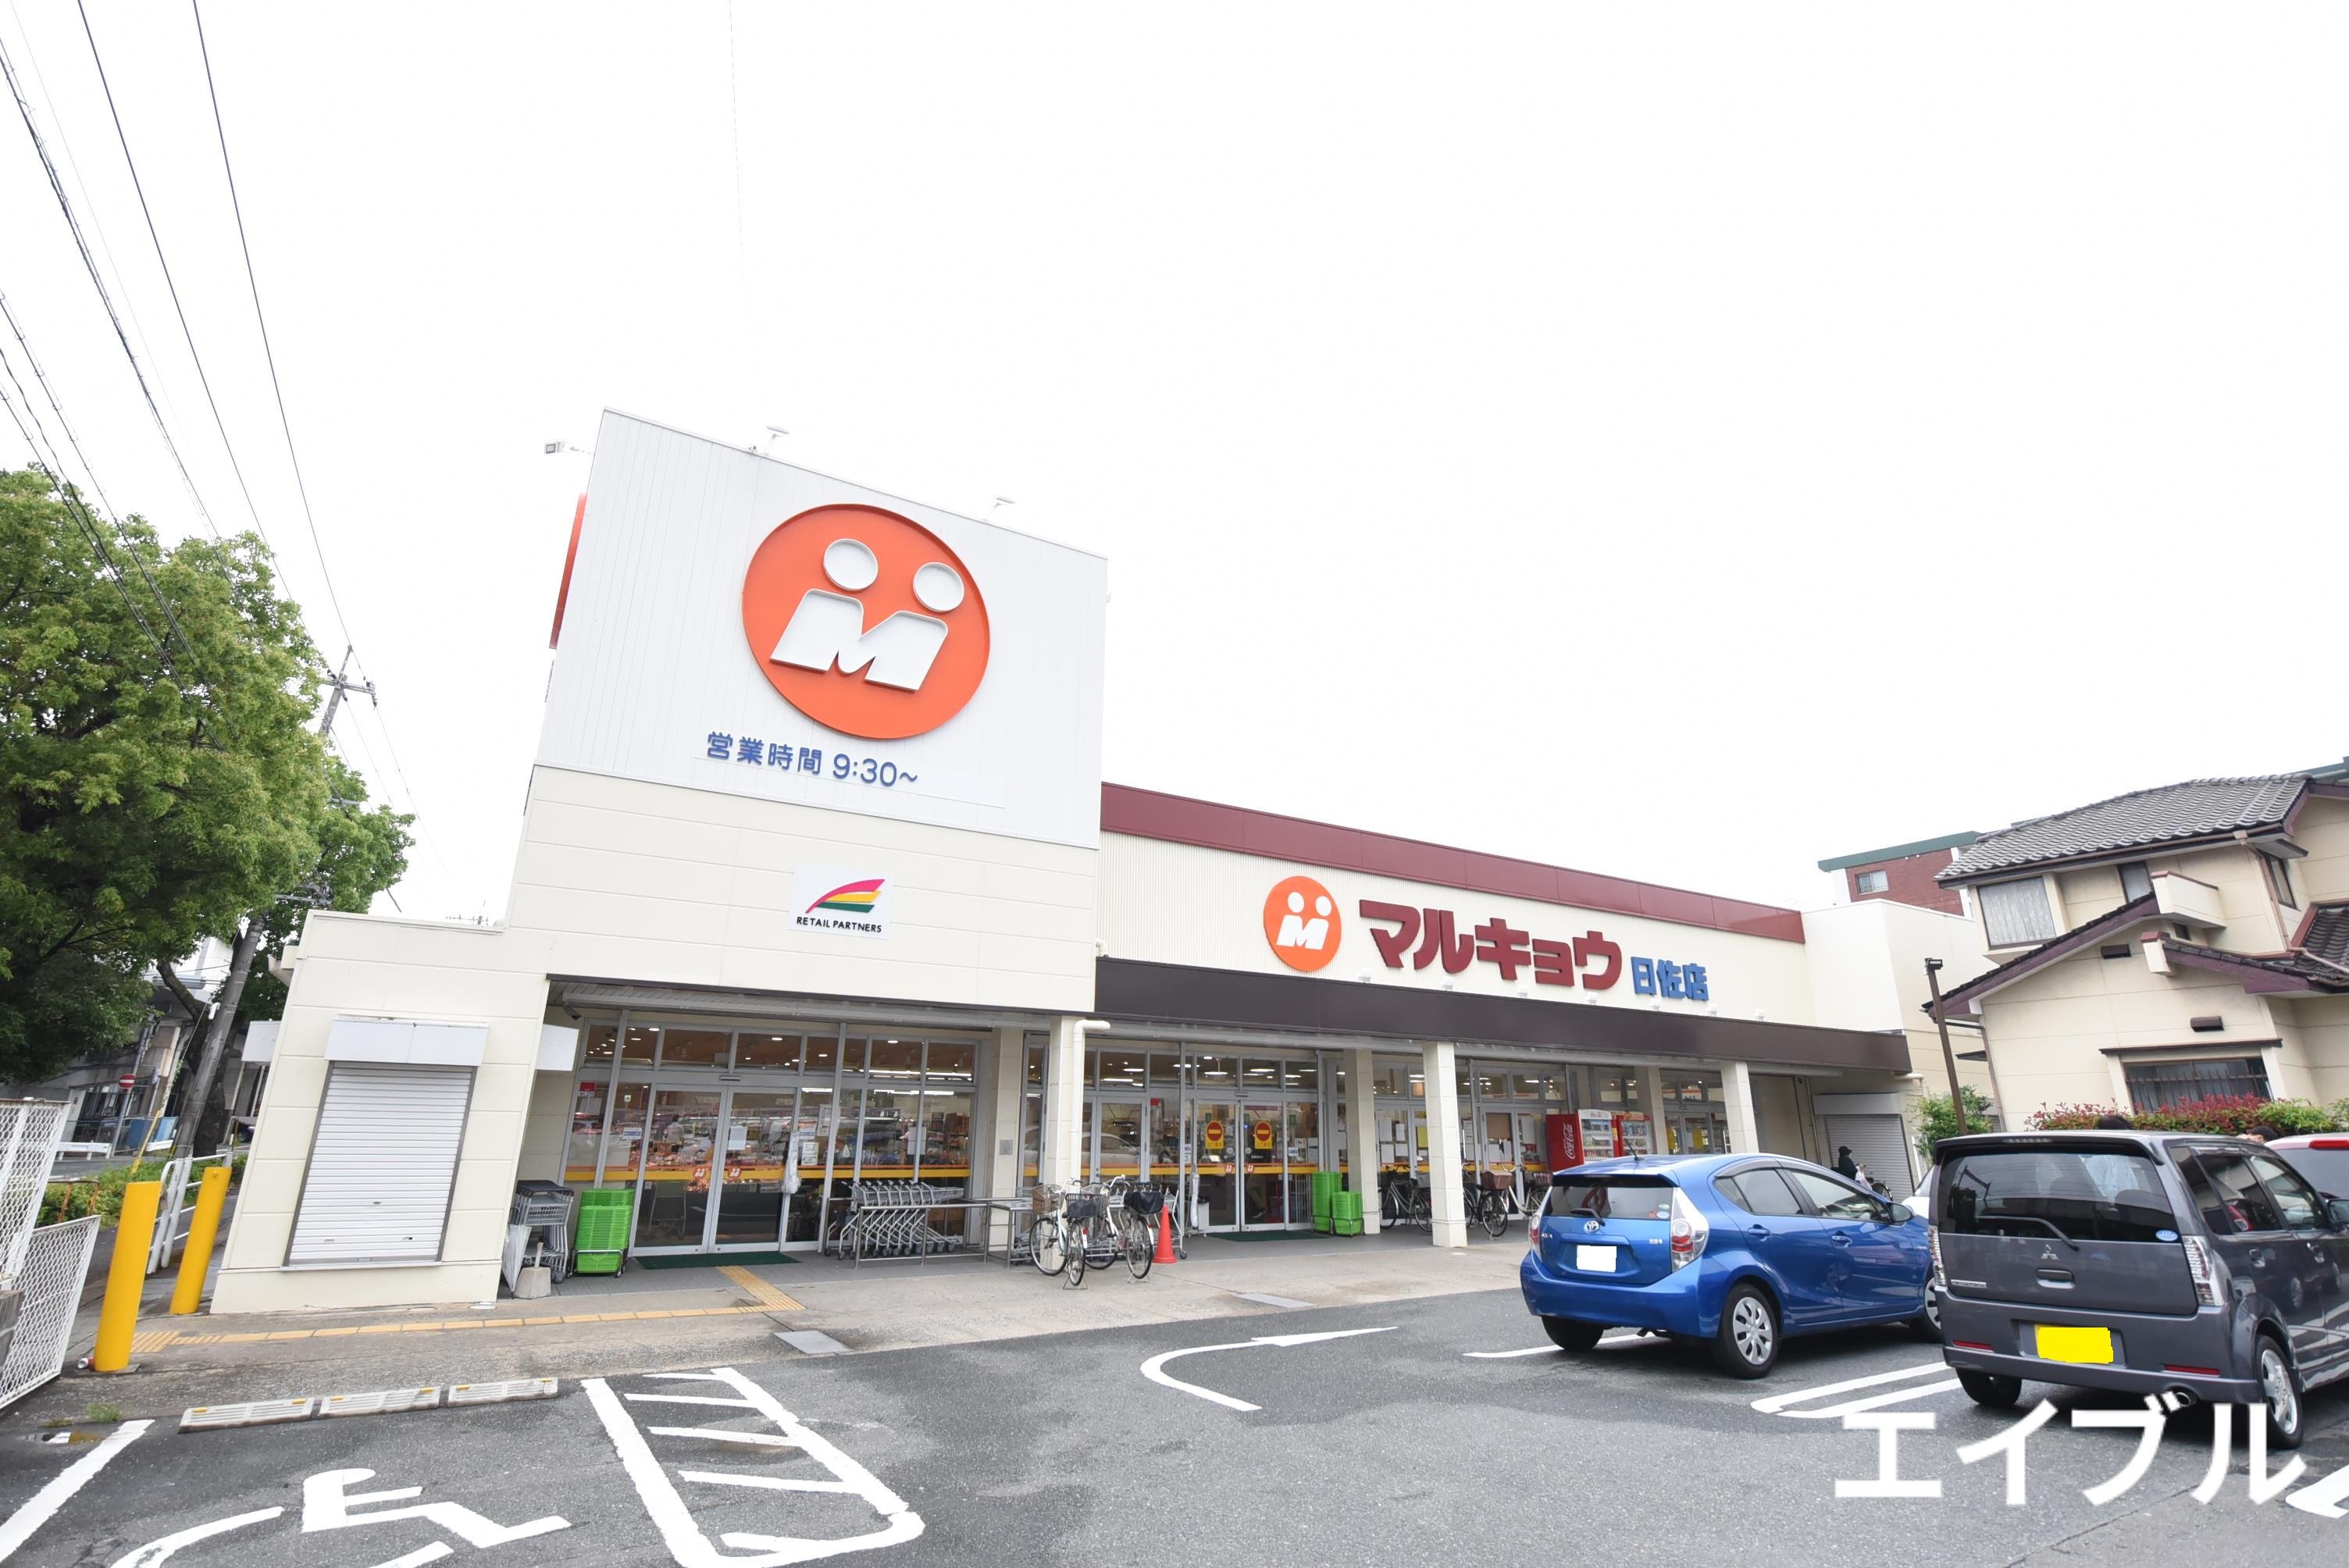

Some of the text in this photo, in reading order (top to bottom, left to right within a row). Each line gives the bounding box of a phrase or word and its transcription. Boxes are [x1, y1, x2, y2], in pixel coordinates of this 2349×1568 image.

[707, 731, 822, 775] 営業時間
[797, 916, 882, 933] RETAIL PARTNERS
[1360, 899, 1709, 1001] マルキョウ 日佐店
